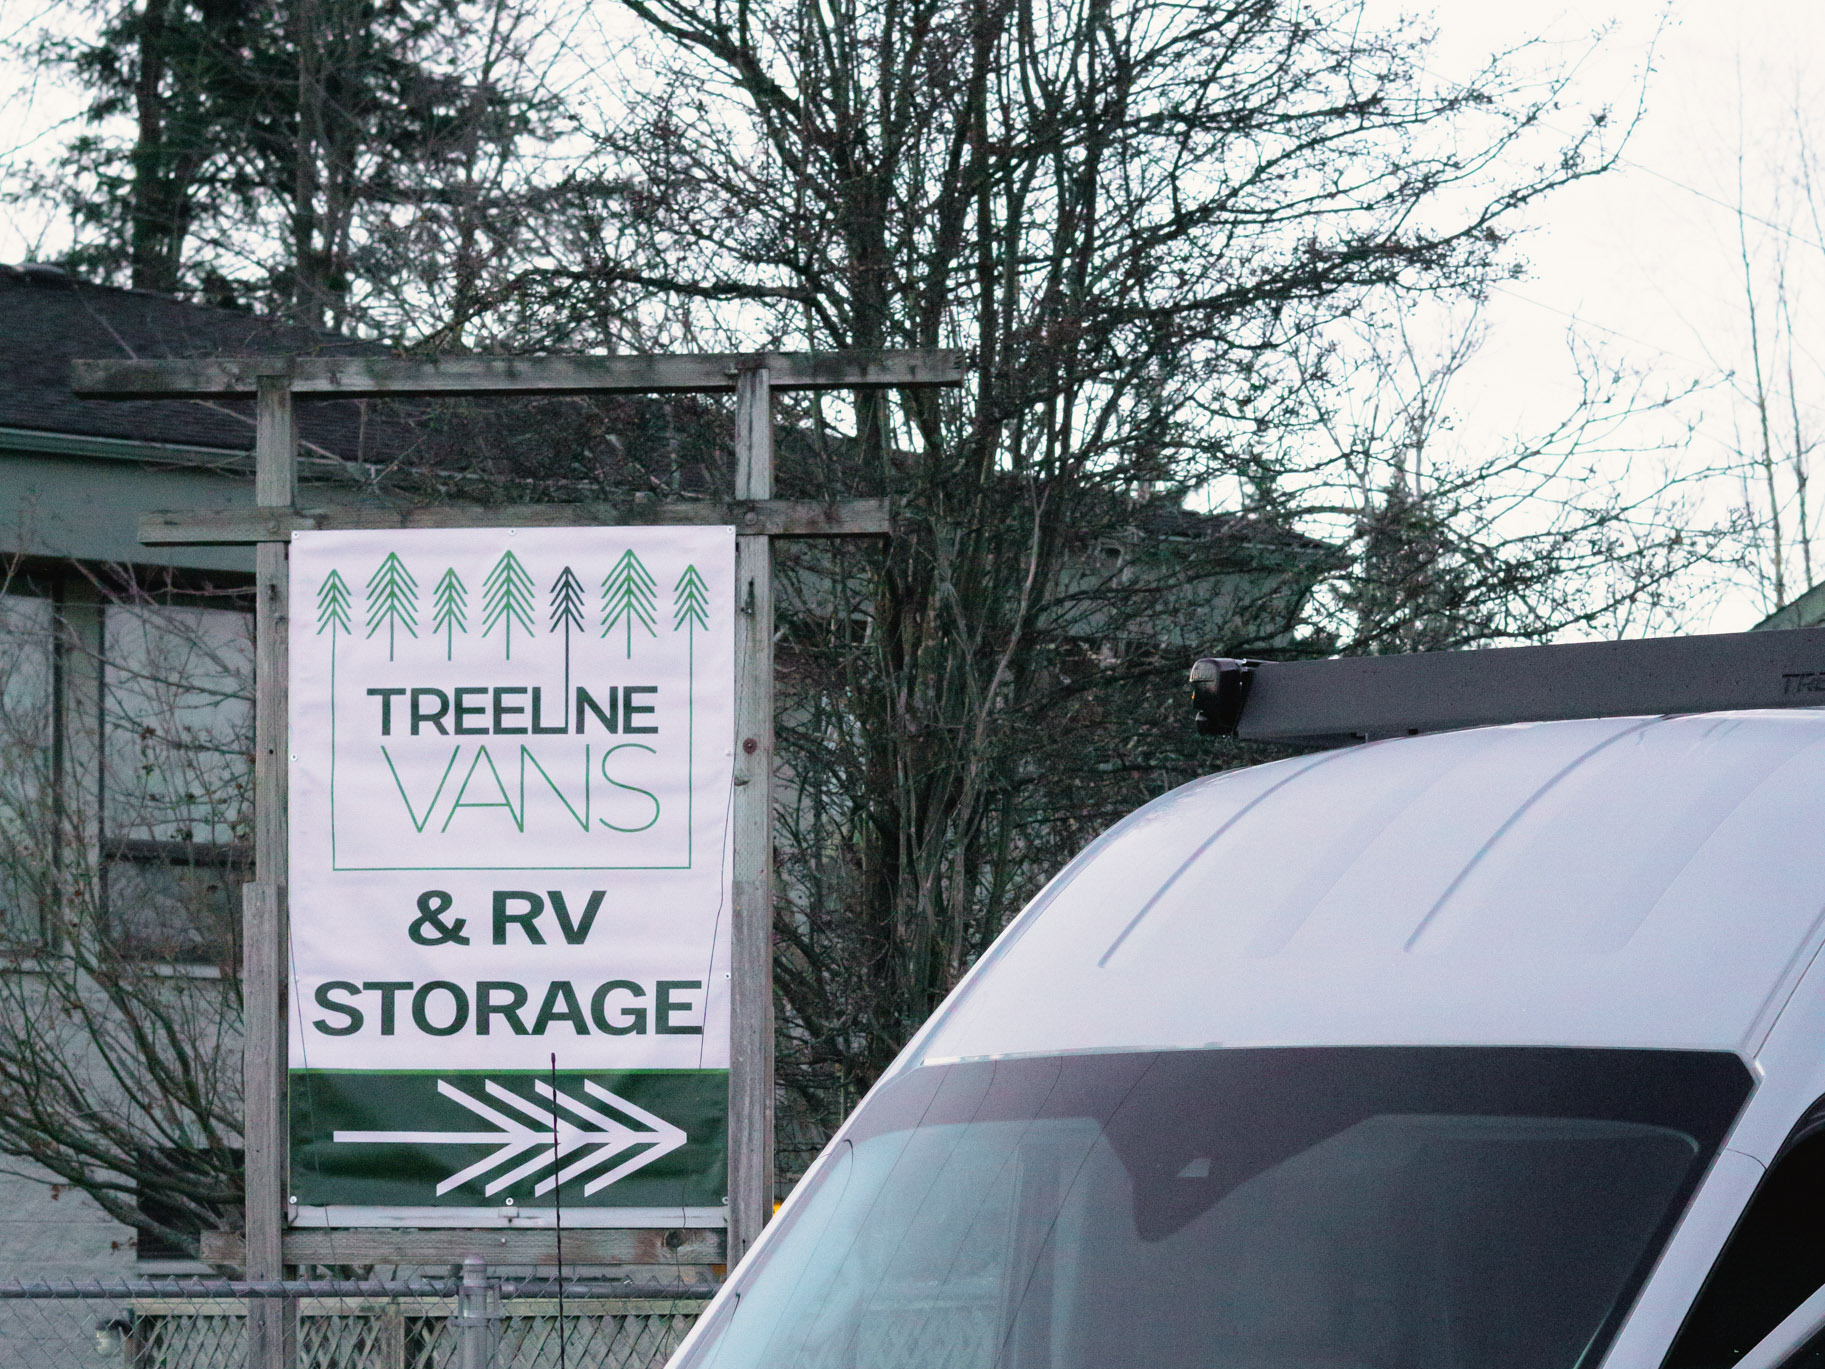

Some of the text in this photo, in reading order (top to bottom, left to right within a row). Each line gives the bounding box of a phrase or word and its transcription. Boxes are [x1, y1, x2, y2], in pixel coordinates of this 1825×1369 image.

[366, 686, 659, 736] TREELINE
[379, 743, 661, 834] VANS
[408, 889, 607, 947] & RV
[312, 979, 703, 1037] STORAGE
